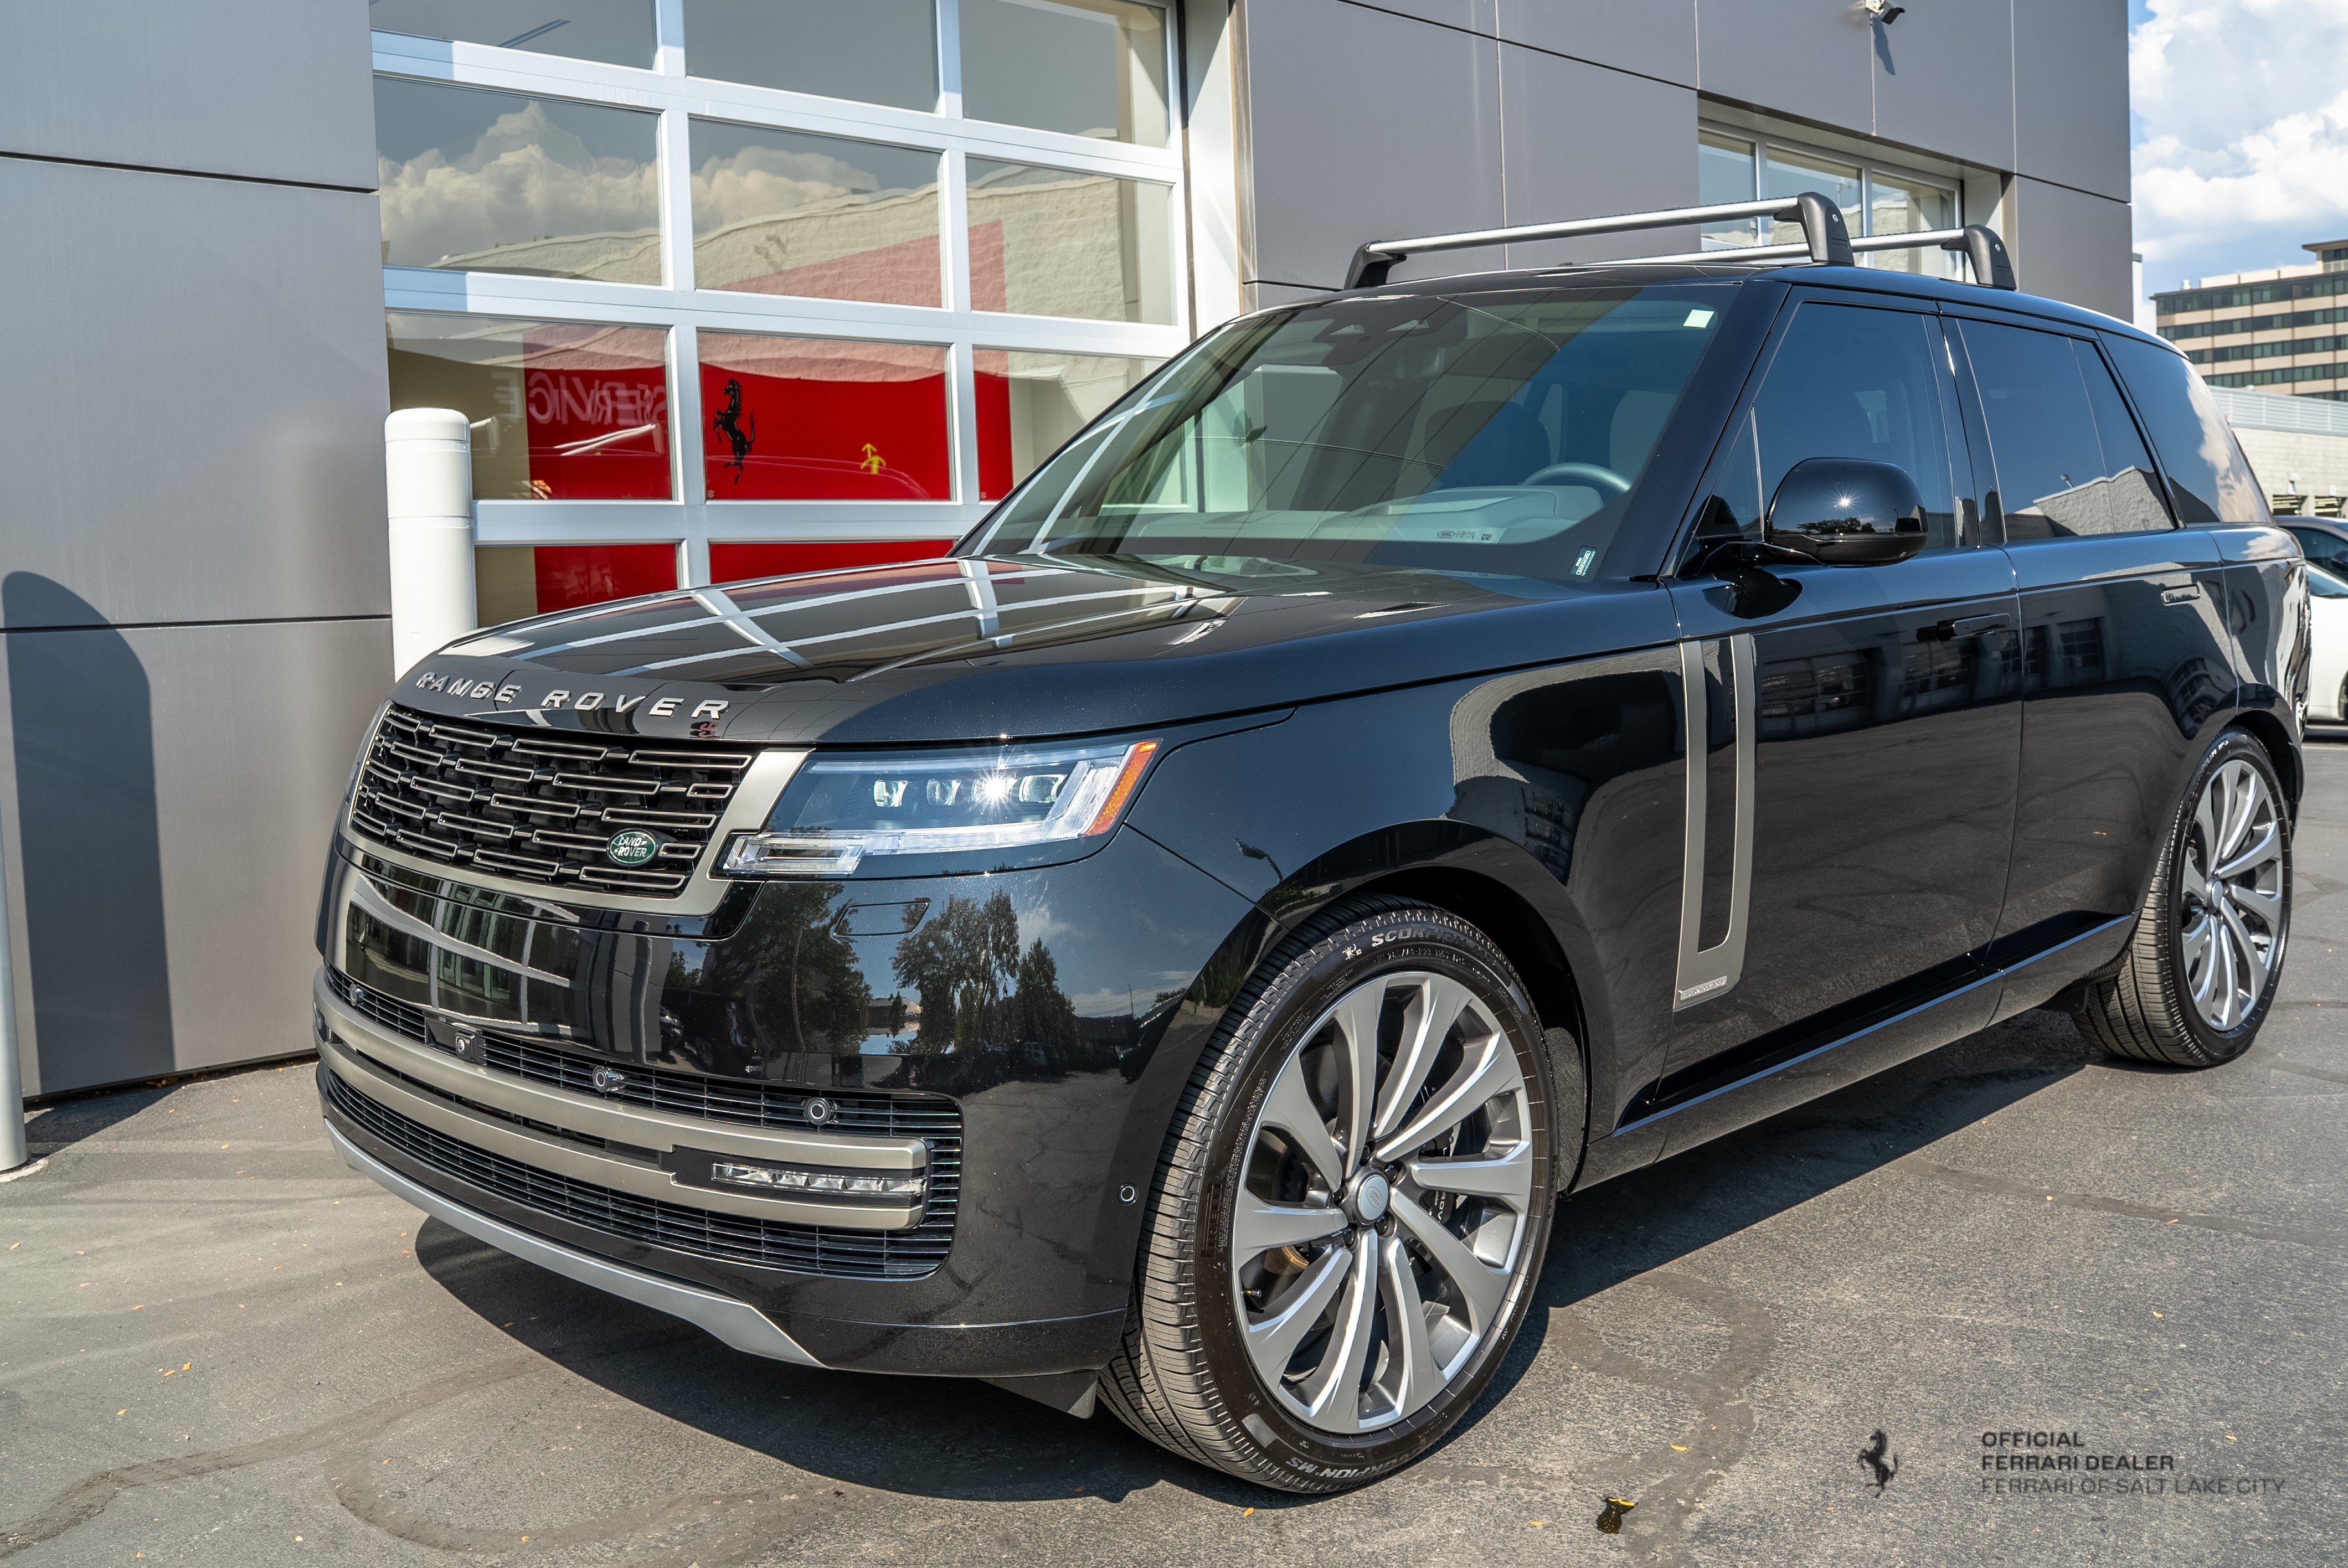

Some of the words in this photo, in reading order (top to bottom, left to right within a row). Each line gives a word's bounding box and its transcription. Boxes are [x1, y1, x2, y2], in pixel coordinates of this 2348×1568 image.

[416, 671, 523, 704] RANGE
[540, 689, 731, 719] ROVER
[617, 836, 642, 847] LAND
[617, 846, 647, 858] ROVER
[1371, 927, 1470, 947] SCORPION
